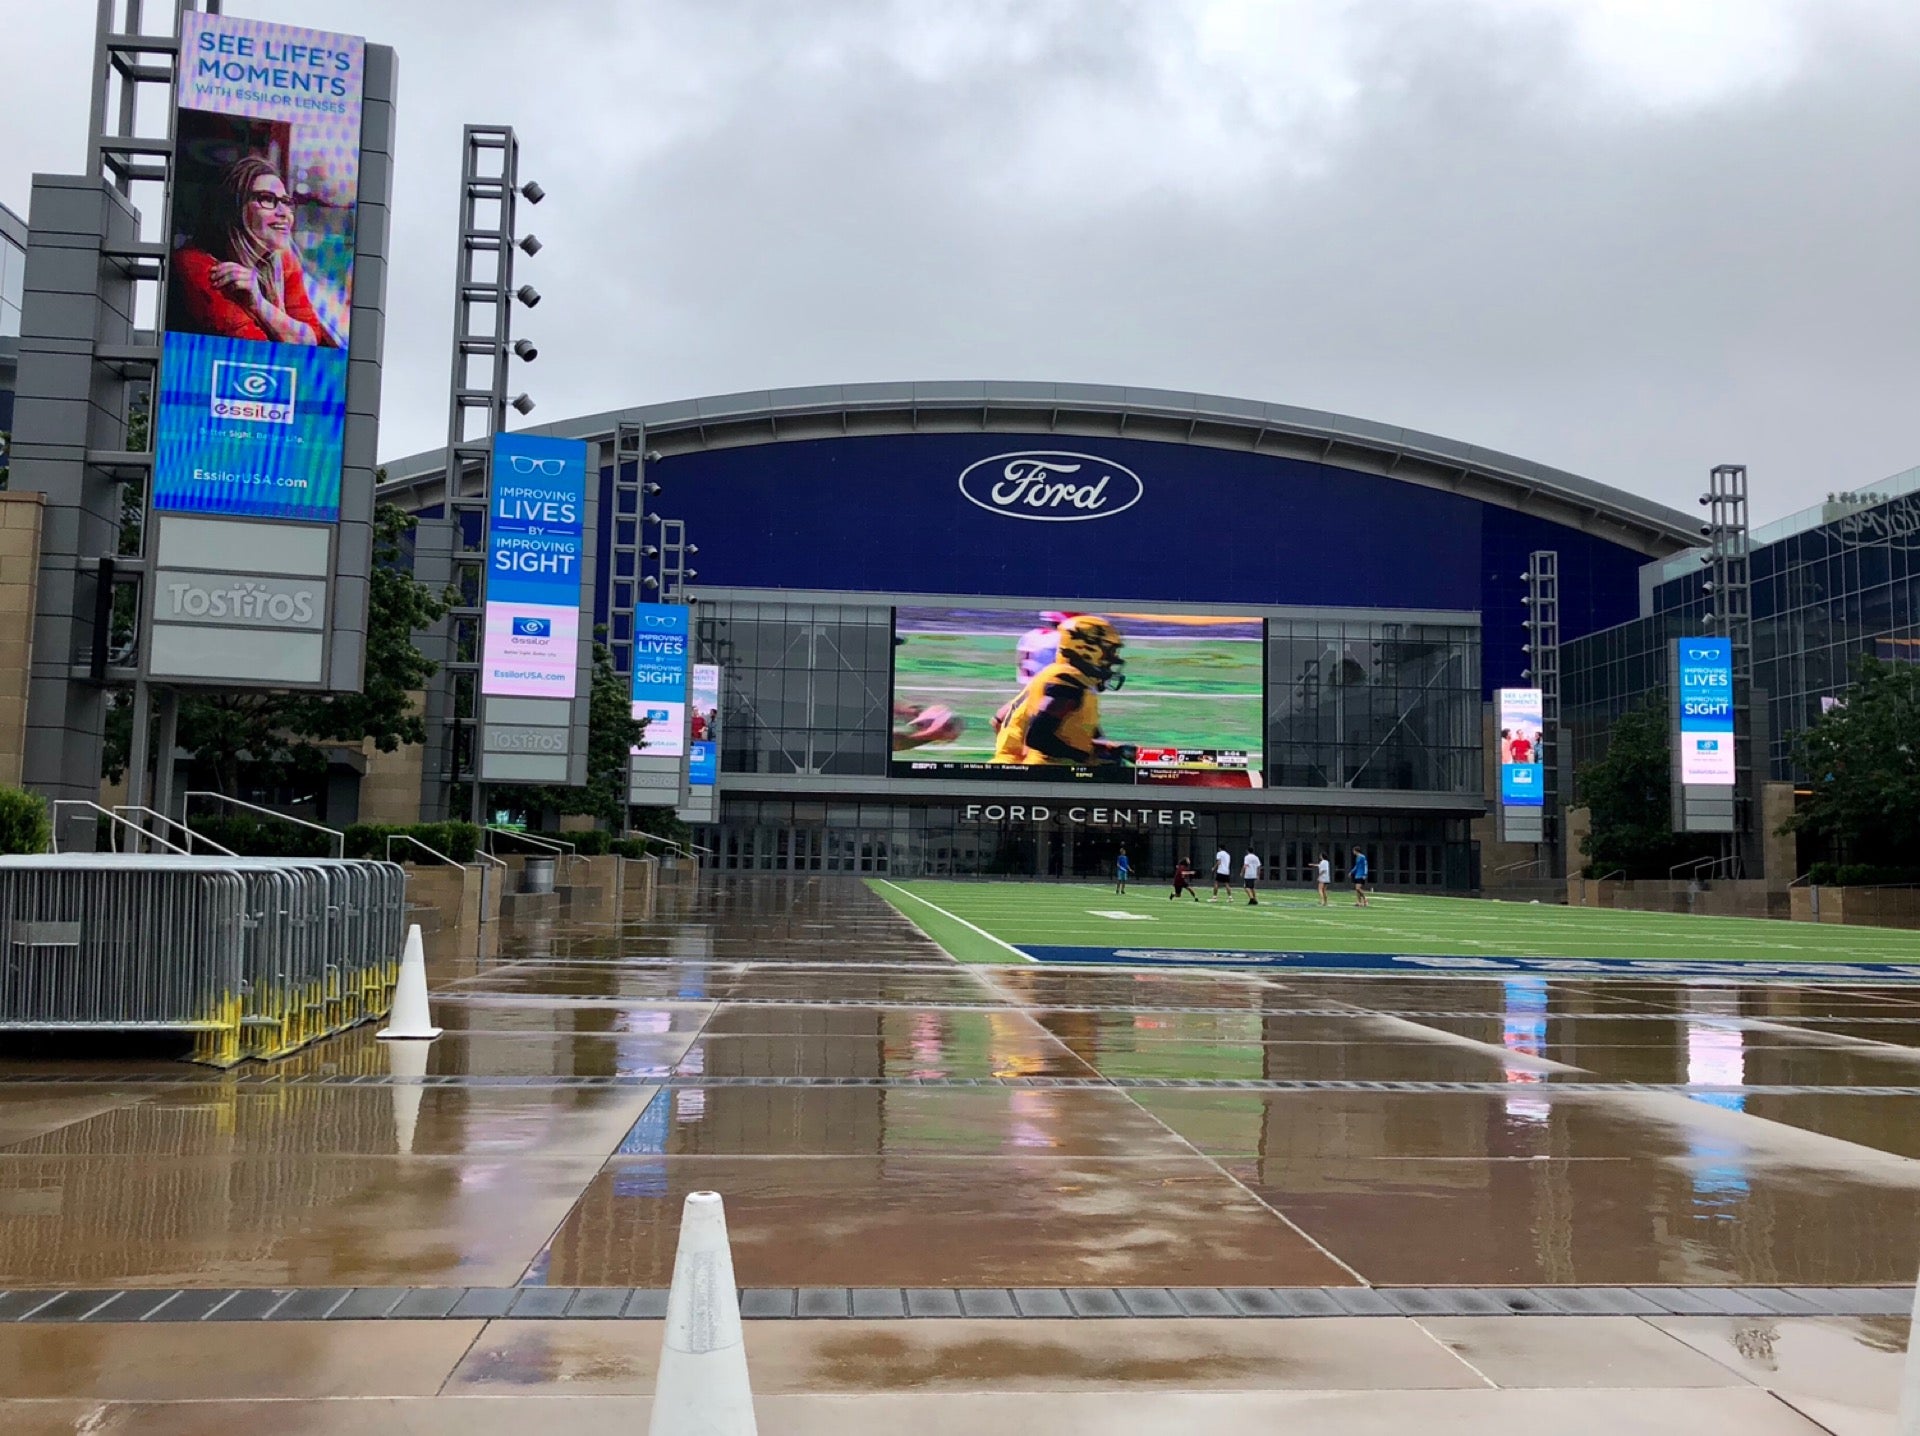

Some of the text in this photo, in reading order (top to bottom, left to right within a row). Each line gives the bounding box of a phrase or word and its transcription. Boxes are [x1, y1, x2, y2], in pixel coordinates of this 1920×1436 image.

[199, 31, 351, 72] SEE LIFE'S
[198, 57, 346, 97] MOMENTS
[195, 83, 346, 114] WITH ESSILOR LENSES
[214, 403, 291, 420] essilor
[991, 458, 1112, 510] Ford
[500, 486, 576, 502] IMPROVING
[499, 498, 576, 524] LIVES
[528, 525, 545, 536] BY
[496, 538, 575, 553] IMPROVING
[495, 550, 576, 575] SIGHT
[639, 634, 683, 643] IMPROVING
[638, 641, 683, 655] LIVES
[637, 664, 682, 672] IMPROVING
[637, 671, 682, 685] SIGHT
[1684, 674, 1728, 687] LIVES
[1684, 696, 1728, 704] IMPROVING
[1684, 703, 1729, 716] SIGHT
[911, 762, 938, 770] ESPN
[966, 804, 1197, 826] FORD CENTER
